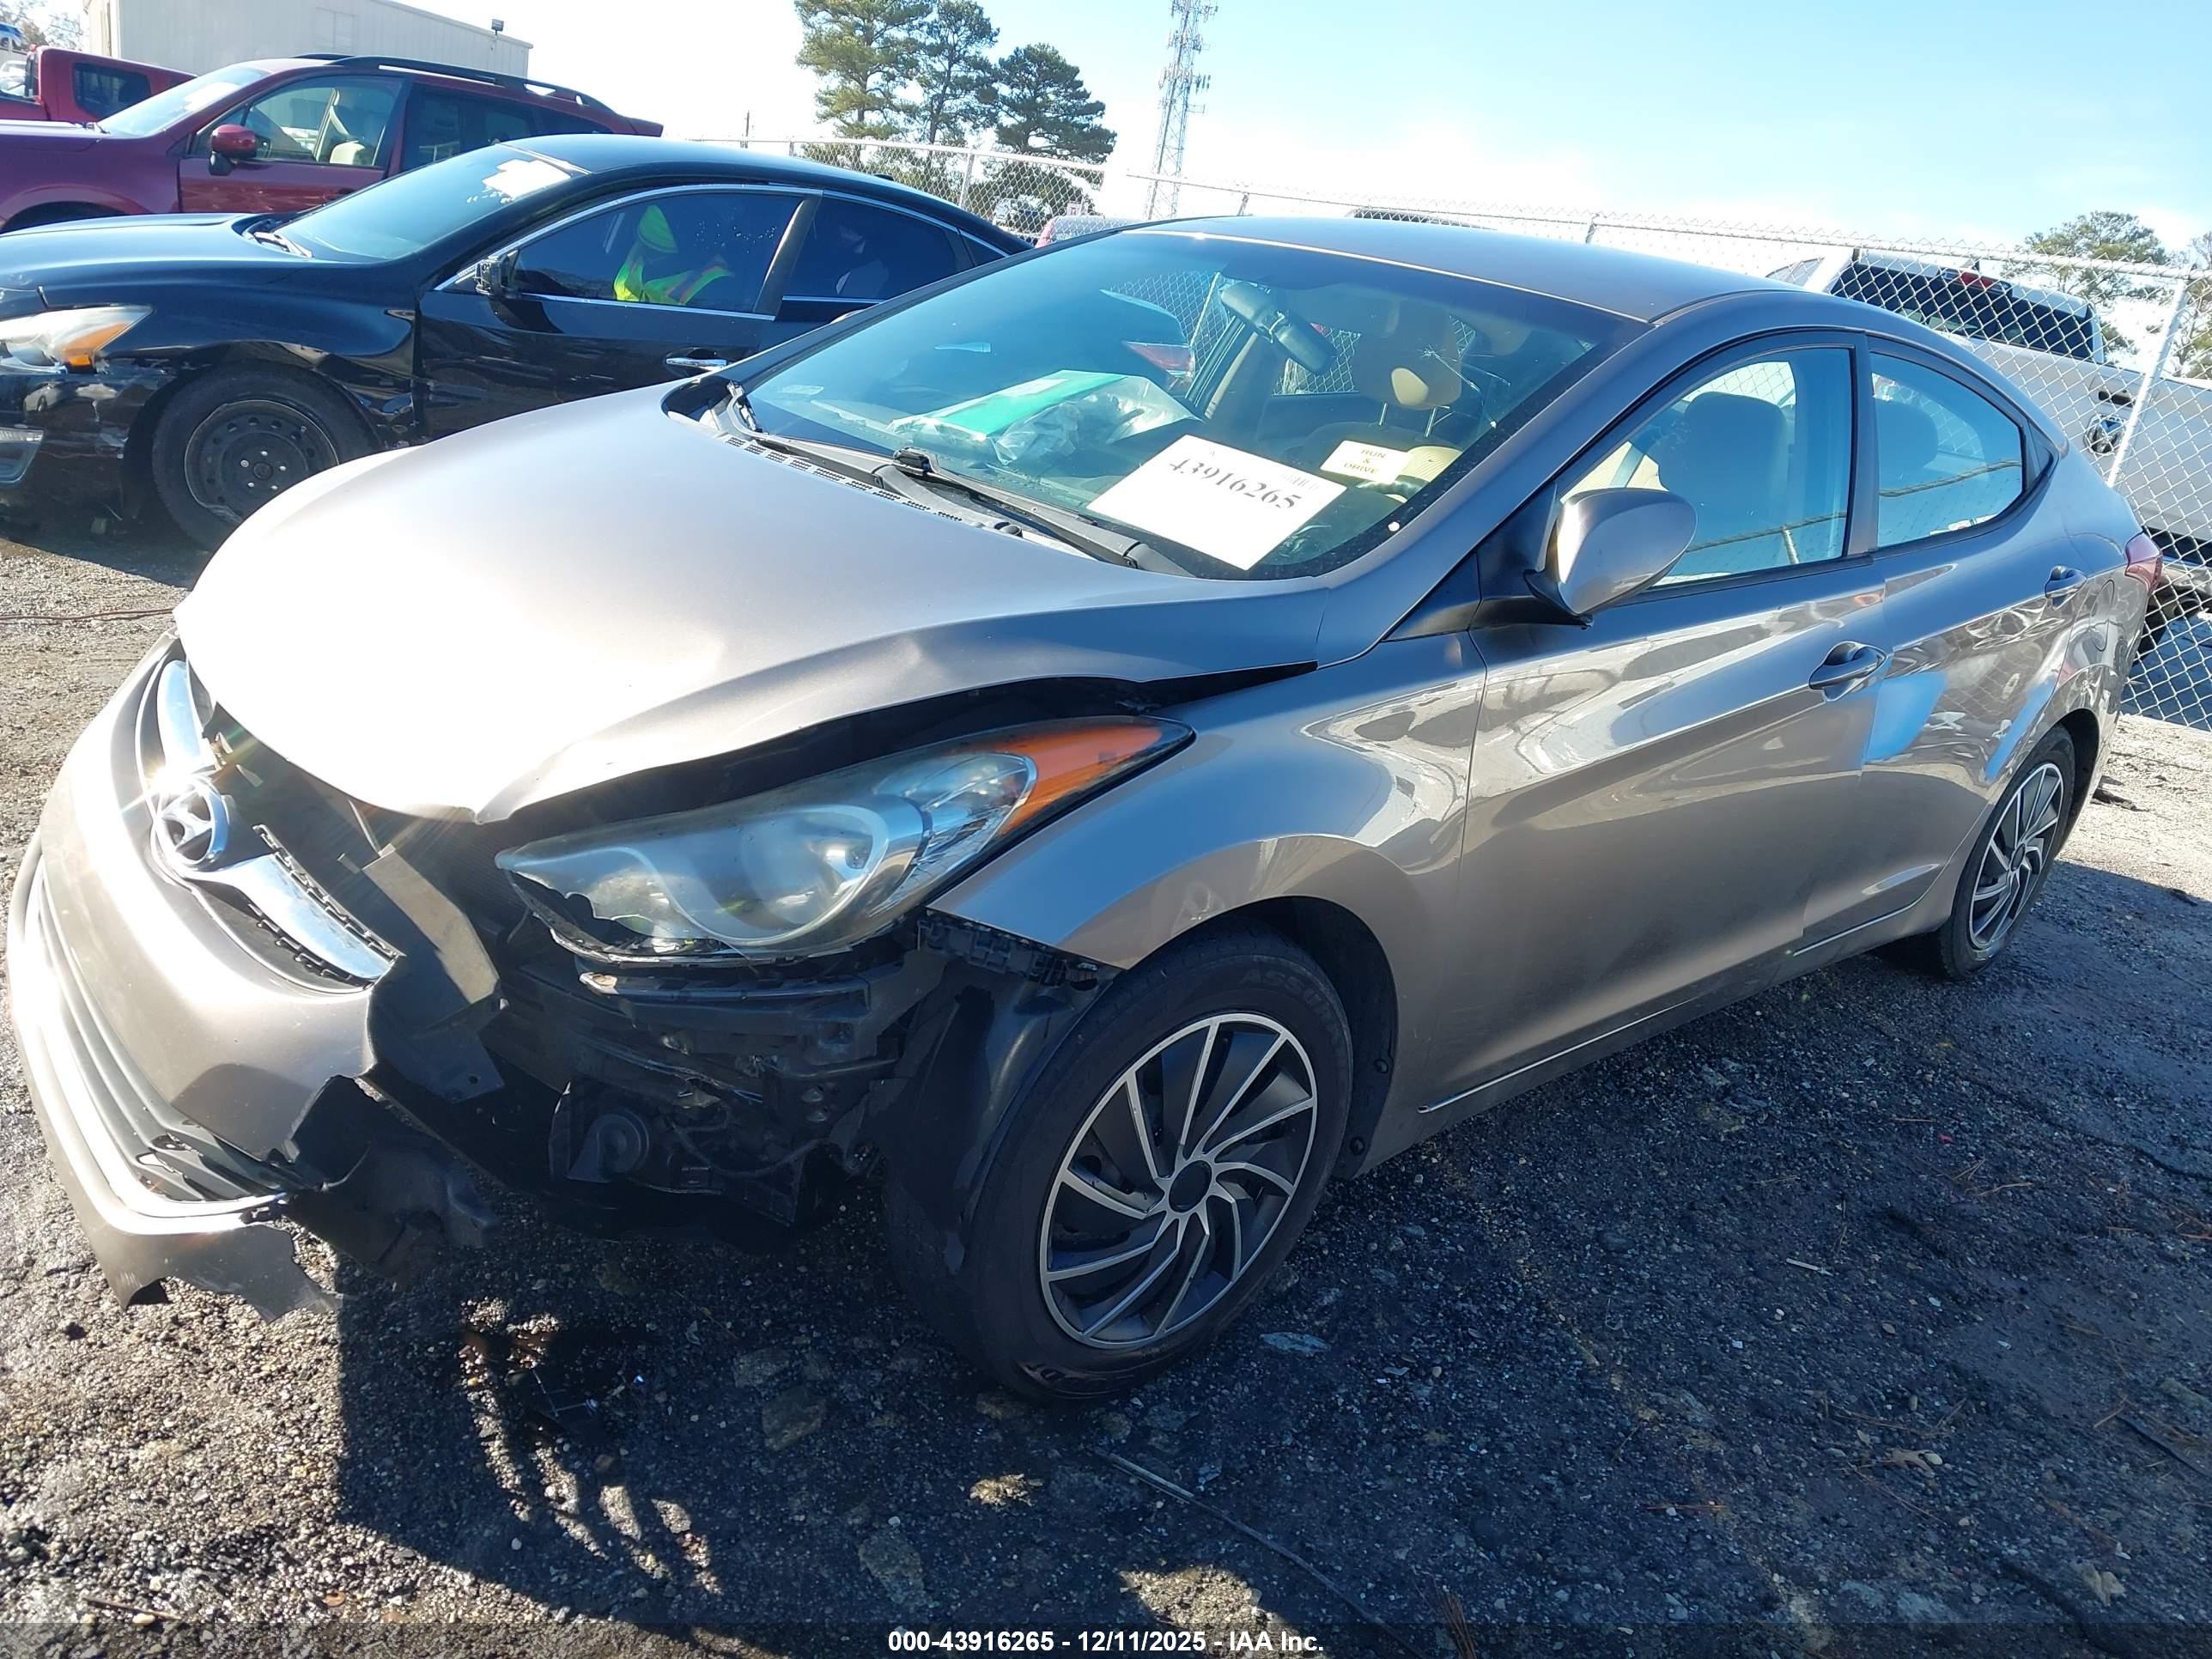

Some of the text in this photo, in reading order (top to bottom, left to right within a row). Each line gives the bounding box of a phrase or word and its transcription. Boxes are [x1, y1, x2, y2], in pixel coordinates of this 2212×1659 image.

[1361, 449, 1386, 459] RUN
[1343, 463, 1377, 474] DRIVE
[1169, 459, 1303, 508] 43916265
